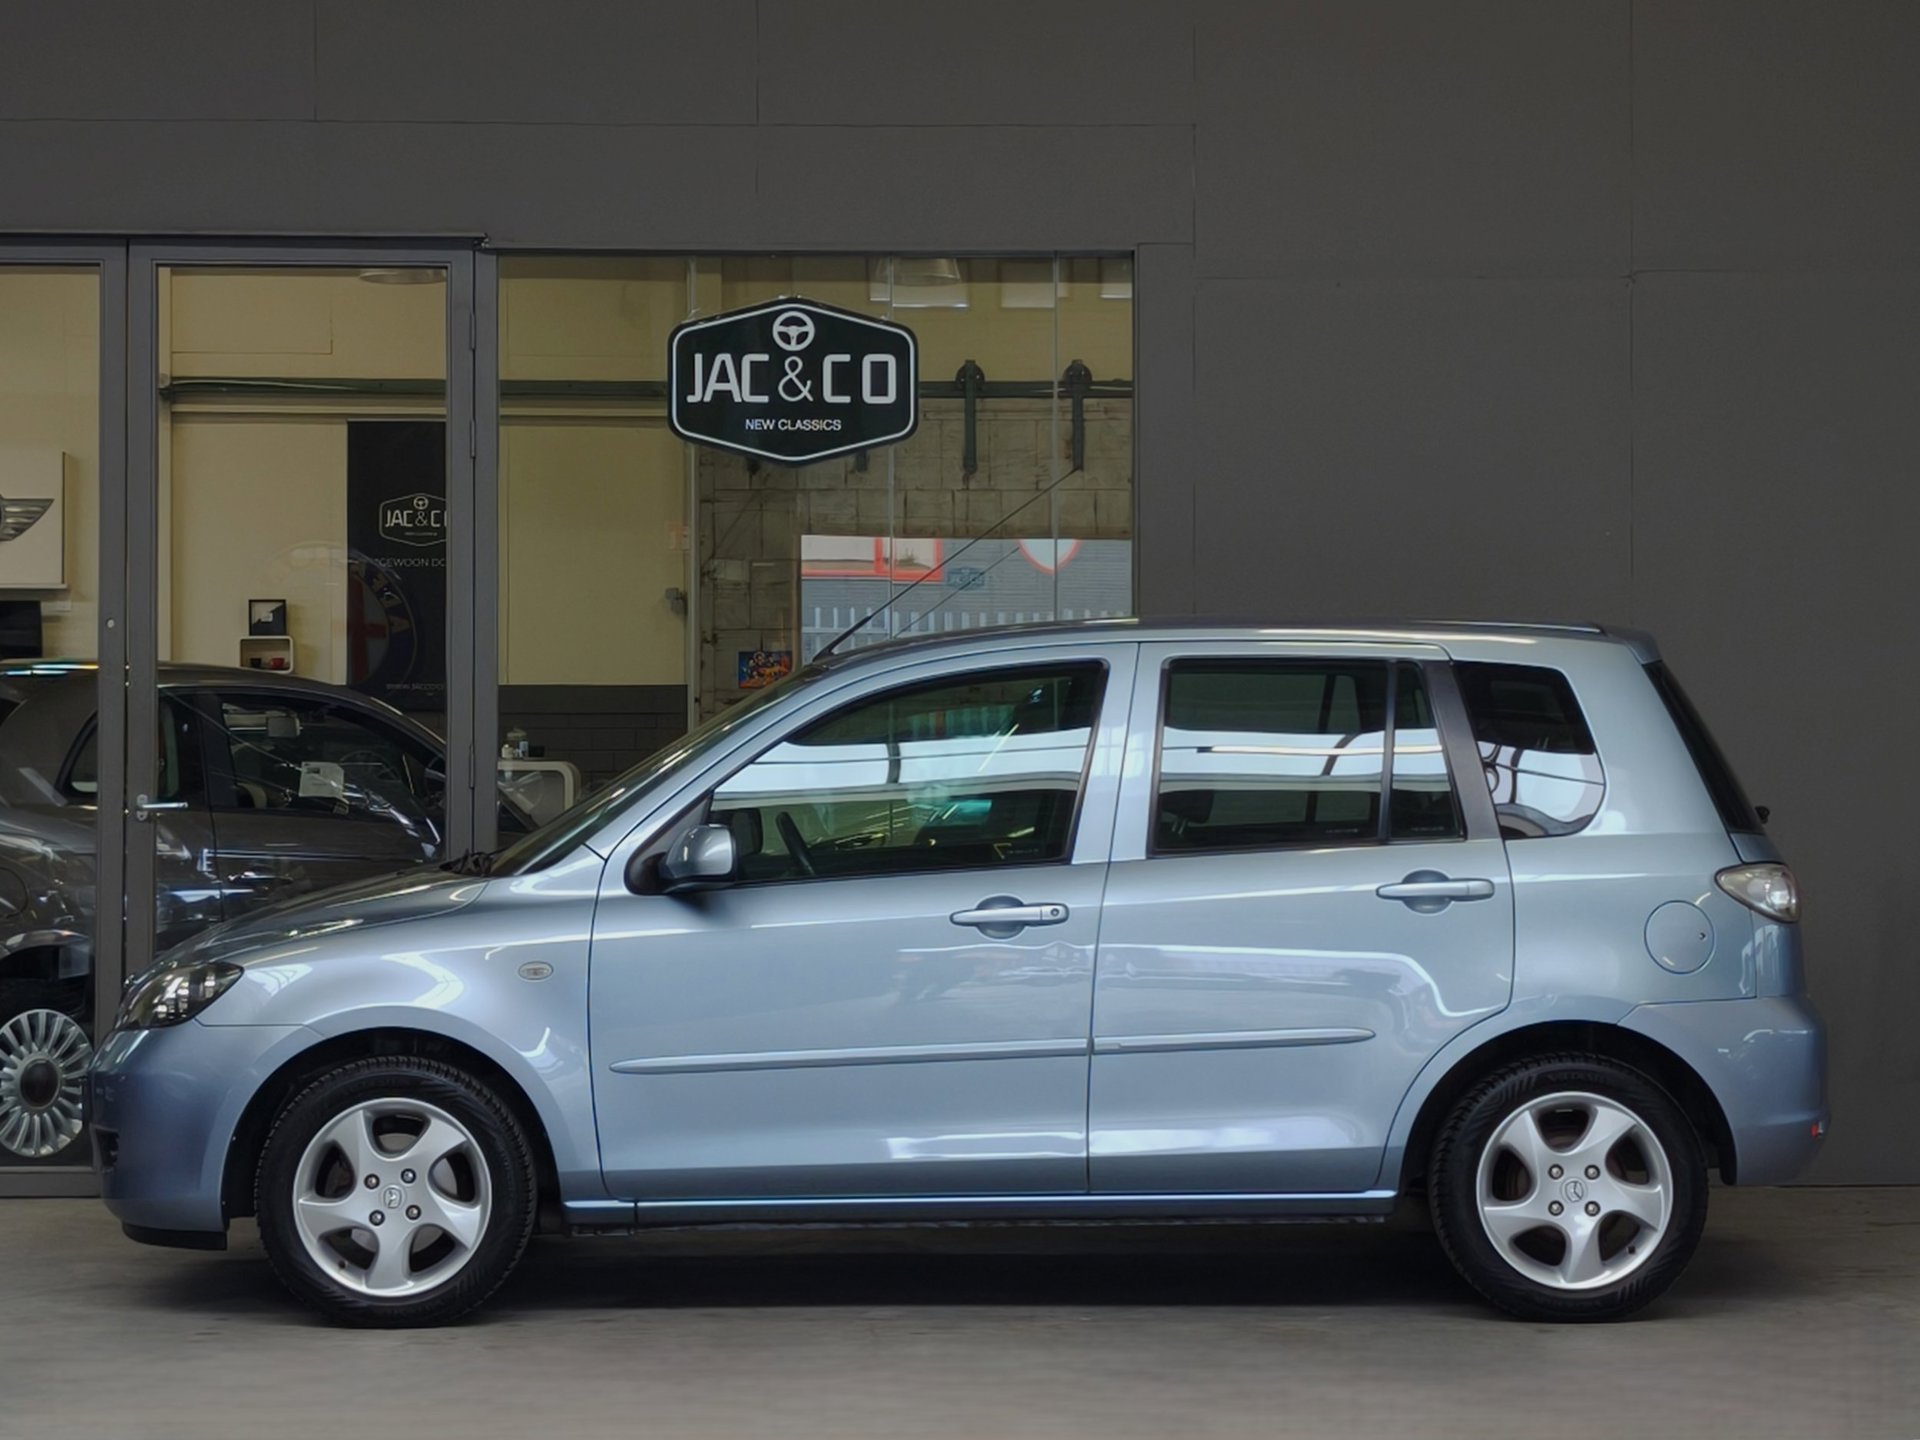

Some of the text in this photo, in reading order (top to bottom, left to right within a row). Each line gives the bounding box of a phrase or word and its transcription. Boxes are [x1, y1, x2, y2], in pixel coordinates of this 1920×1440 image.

[745, 418, 842, 431] NEW CLASSICS
[430, 510, 447, 528] C
